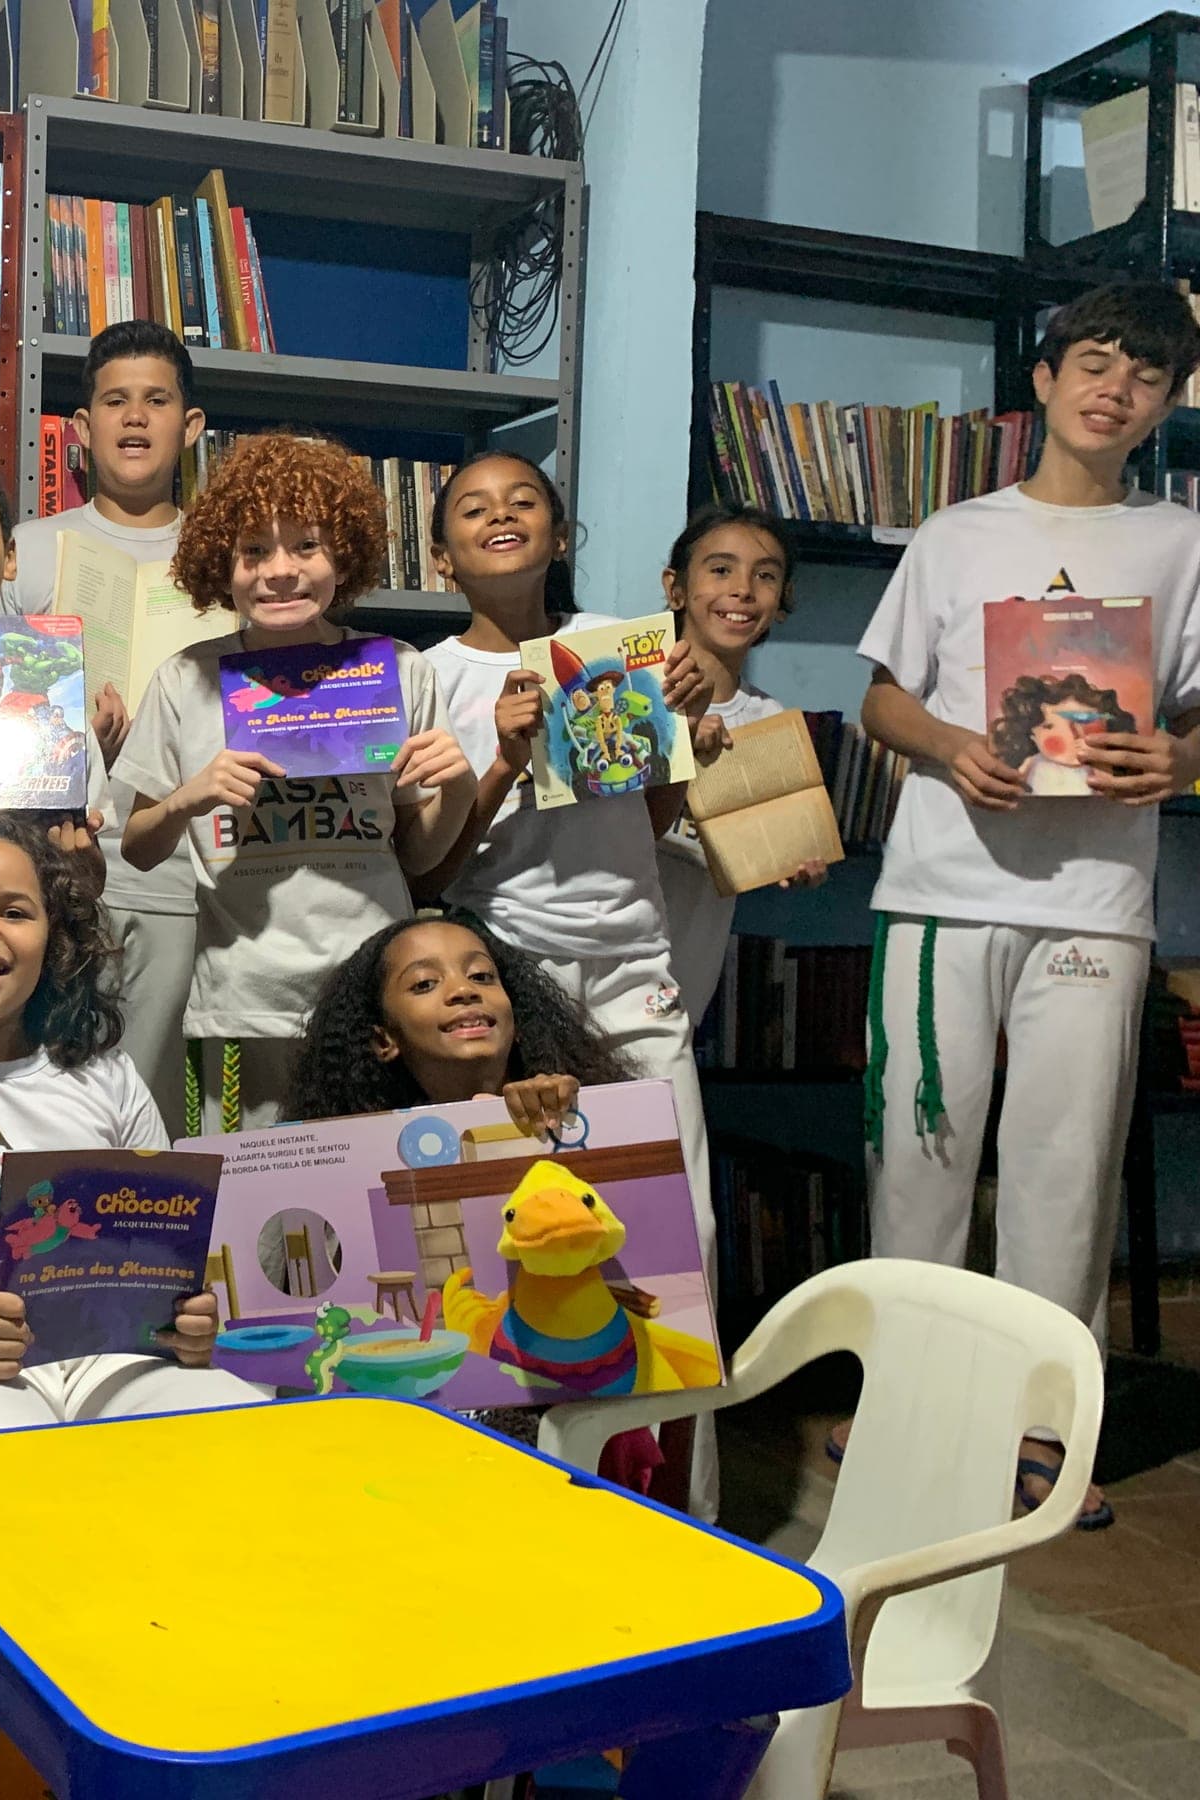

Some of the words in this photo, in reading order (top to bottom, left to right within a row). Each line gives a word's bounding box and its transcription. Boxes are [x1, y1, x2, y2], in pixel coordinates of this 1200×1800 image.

[239, 276, 253, 305] livre
[44, 433, 56, 488] STAR
[1046, 567, 1076, 593] A
[622, 629, 667, 657] TOY
[629, 653, 662, 666] STORY
[266, 713, 305, 726] Reino
[309, 711, 330, 721] dos
[334, 706, 398, 720] Monstros
[24, 777, 69, 790] RÍVEIS
[256, 778, 350, 808] ASA
[213, 805, 383, 849] BAMBAS
[232, 1153, 266, 1163] LAGARTA
[267, 1148, 298, 1159] SURGIU
[317, 1143, 350, 1154] SENTOU
[240, 1138, 277, 1150] NAQUELE
[232, 1164, 258, 1175] BORDA
[260, 1163, 271, 1172] DA
[272, 1161, 300, 1171] TIGELA
[302, 1159, 312, 1167] DE
[120, 1187, 136, 1200] Os
[113, 1220, 165, 1230] JACQUELINE
[165, 1222, 190, 1231] SHOR
[19, 1272, 36, 1284] no
[39, 1265, 85, 1284] Reino
[89, 1261, 114, 1276] dos
[118, 1261, 196, 1280] Monstros
[27, 1286, 60, 1296] aventura
[61, 1285, 75, 1294] que
[75, 1280, 119, 1290] transforma
